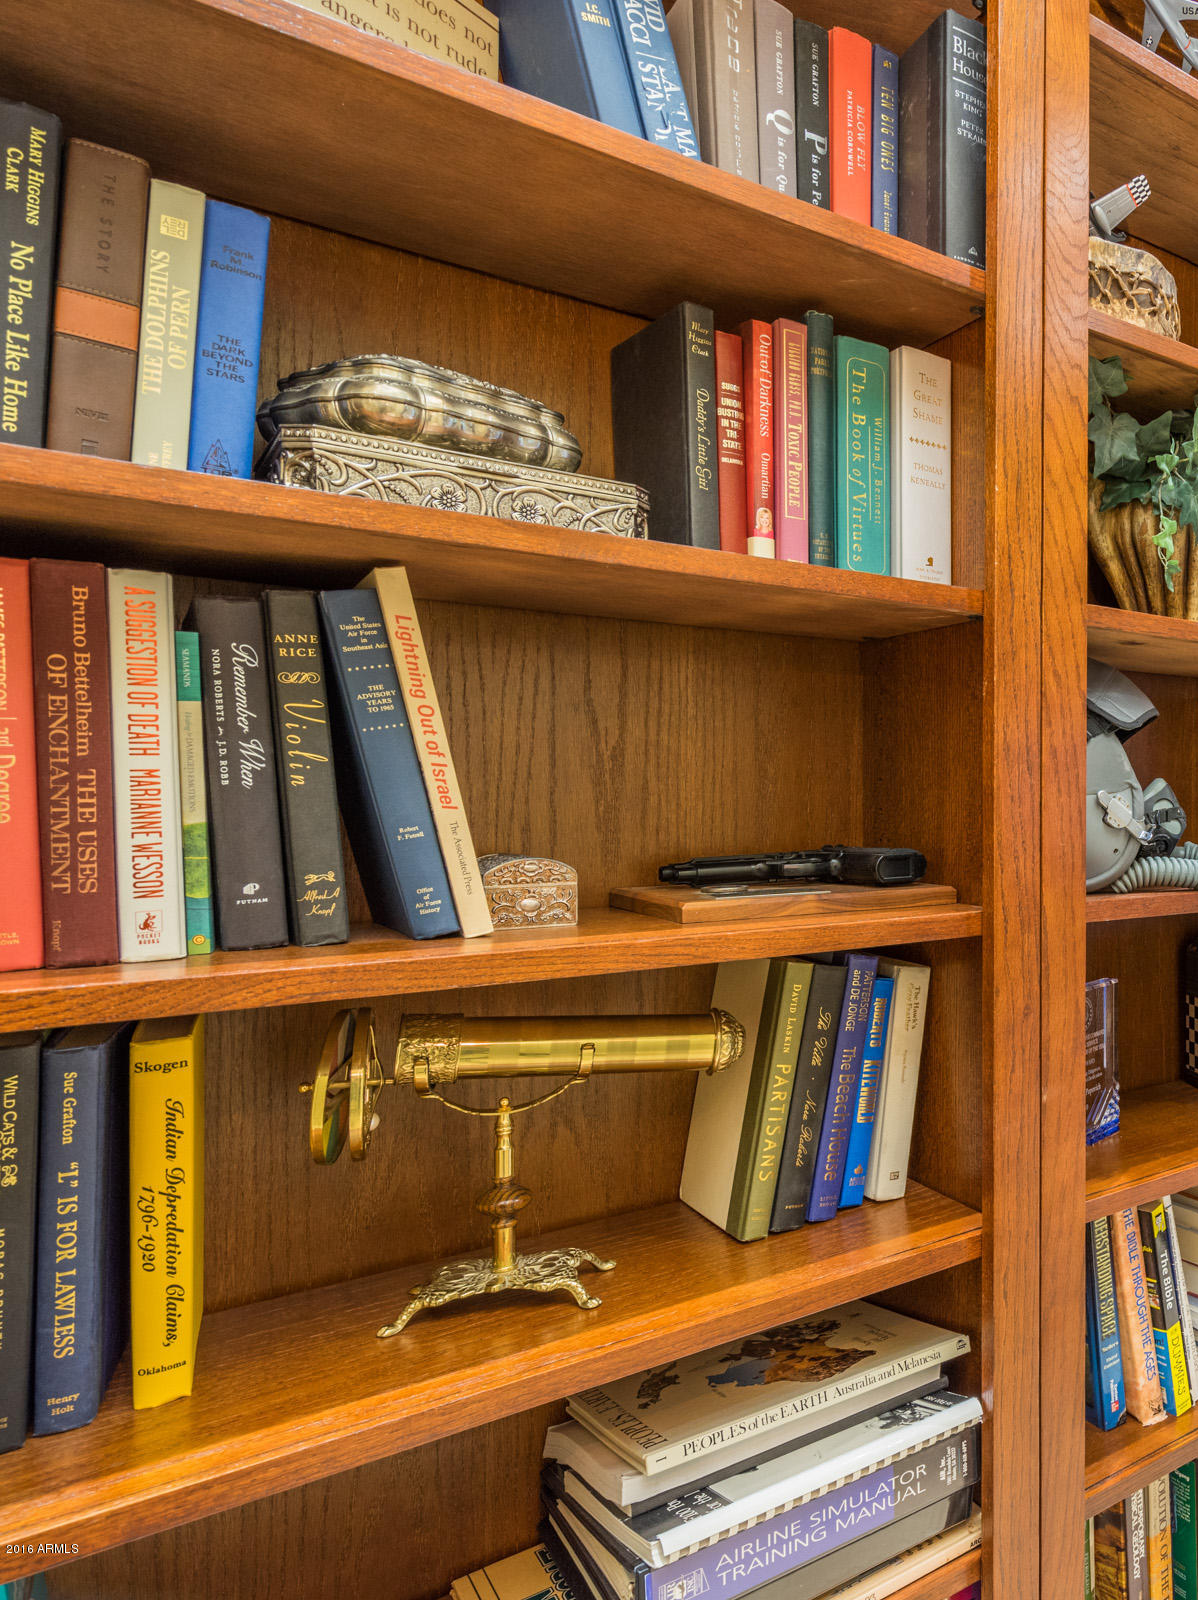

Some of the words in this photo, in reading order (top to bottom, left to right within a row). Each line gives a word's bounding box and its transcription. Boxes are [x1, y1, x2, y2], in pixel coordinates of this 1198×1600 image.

[386, 3, 401, 22] is
[408, 17, 440, 50] not
[581, 12, 611, 28] SMITH
[464, 25, 495, 57] not
[775, 51, 784, 97] GRAFTON
[811, 62, 820, 108] GRAFTON
[846, 89, 854, 130] PATRICIA
[880, 85, 894, 109] TEN
[963, 102, 983, 117] KING
[766, 108, 794, 136] Q
[857, 104, 866, 139] BLOW
[881, 113, 895, 138] BIG
[961, 119, 984, 135] PETER
[28, 126, 47, 164] MARY
[803, 128, 828, 156] P
[857, 144, 867, 172] FLY
[881, 141, 895, 173] ONES
[6, 146, 23, 193] CLARK
[776, 150, 789, 171] for
[811, 167, 822, 188] for
[26, 166, 45, 227] HIGGINS
[101, 174, 117, 210] THE
[11, 240, 35, 271] No
[95, 216, 113, 275] STORY
[221, 244, 254, 262] Frank
[209, 259, 263, 282] Robinson
[7, 274, 34, 325] Place
[143, 249, 172, 356] DOLPHINS
[171, 284, 192, 335] PERN
[5, 328, 32, 374] Like
[166, 339, 187, 371] OF
[211, 341, 246, 358] DARK
[217, 334, 242, 347] THE
[201, 349, 254, 369] BEYOND
[206, 367, 246, 385] STARS
[215, 360, 239, 374] THE
[140, 358, 163, 396] THE
[852, 367, 868, 406] The
[918, 371, 938, 389] THE
[1, 375, 28, 434] Home
[695, 388, 710, 432] Daddy's
[721, 397, 742, 410] UNION
[759, 377, 772, 438] Darkness
[913, 389, 943, 407] GREAT
[912, 407, 944, 426] SHAME
[697, 433, 711, 467] Little
[722, 439, 742, 450] STATE
[788, 423, 803, 458] TOXIC
[852, 412, 867, 463] Book
[872, 417, 883, 462] William
[696, 465, 712, 491] Girl
[761, 452, 771, 499] Omartian
[788, 461, 803, 508] PEOPLE
[848, 467, 866, 489] of
[910, 476, 946, 491] KENEALLY
[913, 462, 944, 476] THOMAS
[873, 479, 883, 524] Bennett
[852, 491, 868, 563] Virtues
[71, 584, 89, 649] Bruno
[123, 599, 158, 688] SUGGESTION
[274, 633, 319, 645] ANNE
[278, 647, 317, 658] RICE
[342, 644, 374, 653] Southeast
[45, 653, 68, 680] OF
[211, 648, 222, 676] NORA
[394, 614, 427, 700] Lightning
[72, 651, 91, 758] Bettelheim
[126, 690, 159, 710] OF
[213, 679, 225, 722] ROBERTS
[231, 642, 259, 734] Remember
[356, 689, 397, 700] ADVISORY
[366, 698, 392, 706] YEARS
[368, 684, 384, 692] THE
[127, 713, 160, 757] DEATH
[417, 704, 438, 739] Out
[283, 698, 328, 787] Violin
[426, 741, 445, 759] of
[219, 760, 229, 786] ROBB
[238, 738, 266, 790] When
[47, 683, 71, 896] ENCHANTMENT
[76, 768, 97, 824] THE
[430, 760, 458, 811] Israel
[129, 769, 162, 840] MARIANNE
[449, 820, 459, 835] The
[76, 828, 98, 895] USES
[130, 842, 164, 900] WESSON
[453, 837, 471, 876] Associated
[463, 875, 473, 896] Press
[789, 983, 802, 1014] DAVID
[783, 1016, 798, 1054] LASKIN
[869, 997, 888, 1048] ROBERTS
[134, 1058, 189, 1074] Skogen
[840, 1046, 857, 1071] The
[2, 1074, 19, 1109] WILD
[63, 1071, 78, 1096] Sue
[832, 1073, 855, 1125] Beach
[61, 1097, 77, 1145] Grafton
[164, 1097, 184, 1162] Indian
[757, 1063, 792, 1183] PARTISANS
[824, 1127, 850, 1182] House
[57, 1194, 78, 1216] IS
[158, 1166, 187, 1279] Depredation
[56, 1220, 78, 1262] FOR
[140, 1185, 157, 1273] 1796-1920
[1125, 1231, 1140, 1264] BIBLE
[1160, 1250, 1170, 1276] The
[1130, 1264, 1148, 1323] THROUGH
[1160, 1276, 1173, 1311] Bible
[53, 1268, 77, 1360] LAWLESS
[161, 1282, 185, 1348] Claims,
[1100, 1302, 1117, 1339] SPACE
[1139, 1322, 1152, 1349] THE
[137, 1360, 188, 1378] Oklahoma
[1143, 1351, 1157, 1382] AGES
[1171, 1334, 1187, 1396] DUMMIES
[47, 1393, 80, 1407] Henry
[51, 1404, 75, 1416] Holt
[682, 1417, 746, 1458] PEOPLES
[747, 1416, 760, 1431] of
[761, 1408, 779, 1425] the
[779, 1391, 829, 1420] EARTH
[833, 1373, 878, 1399] Australia
[876, 1365, 896, 1382] and
[897, 1350, 942, 1376] Melanesia
[715, 1519, 801, 1572] AIRLINE
[808, 1463, 928, 1529] SIMULATOR
[717, 1525, 827, 1587] TRAINING
[835, 1481, 928, 1534] MANUAL
[1159, 1544, 1169, 1561] OF
[1160, 1564, 1170, 1594] THE
